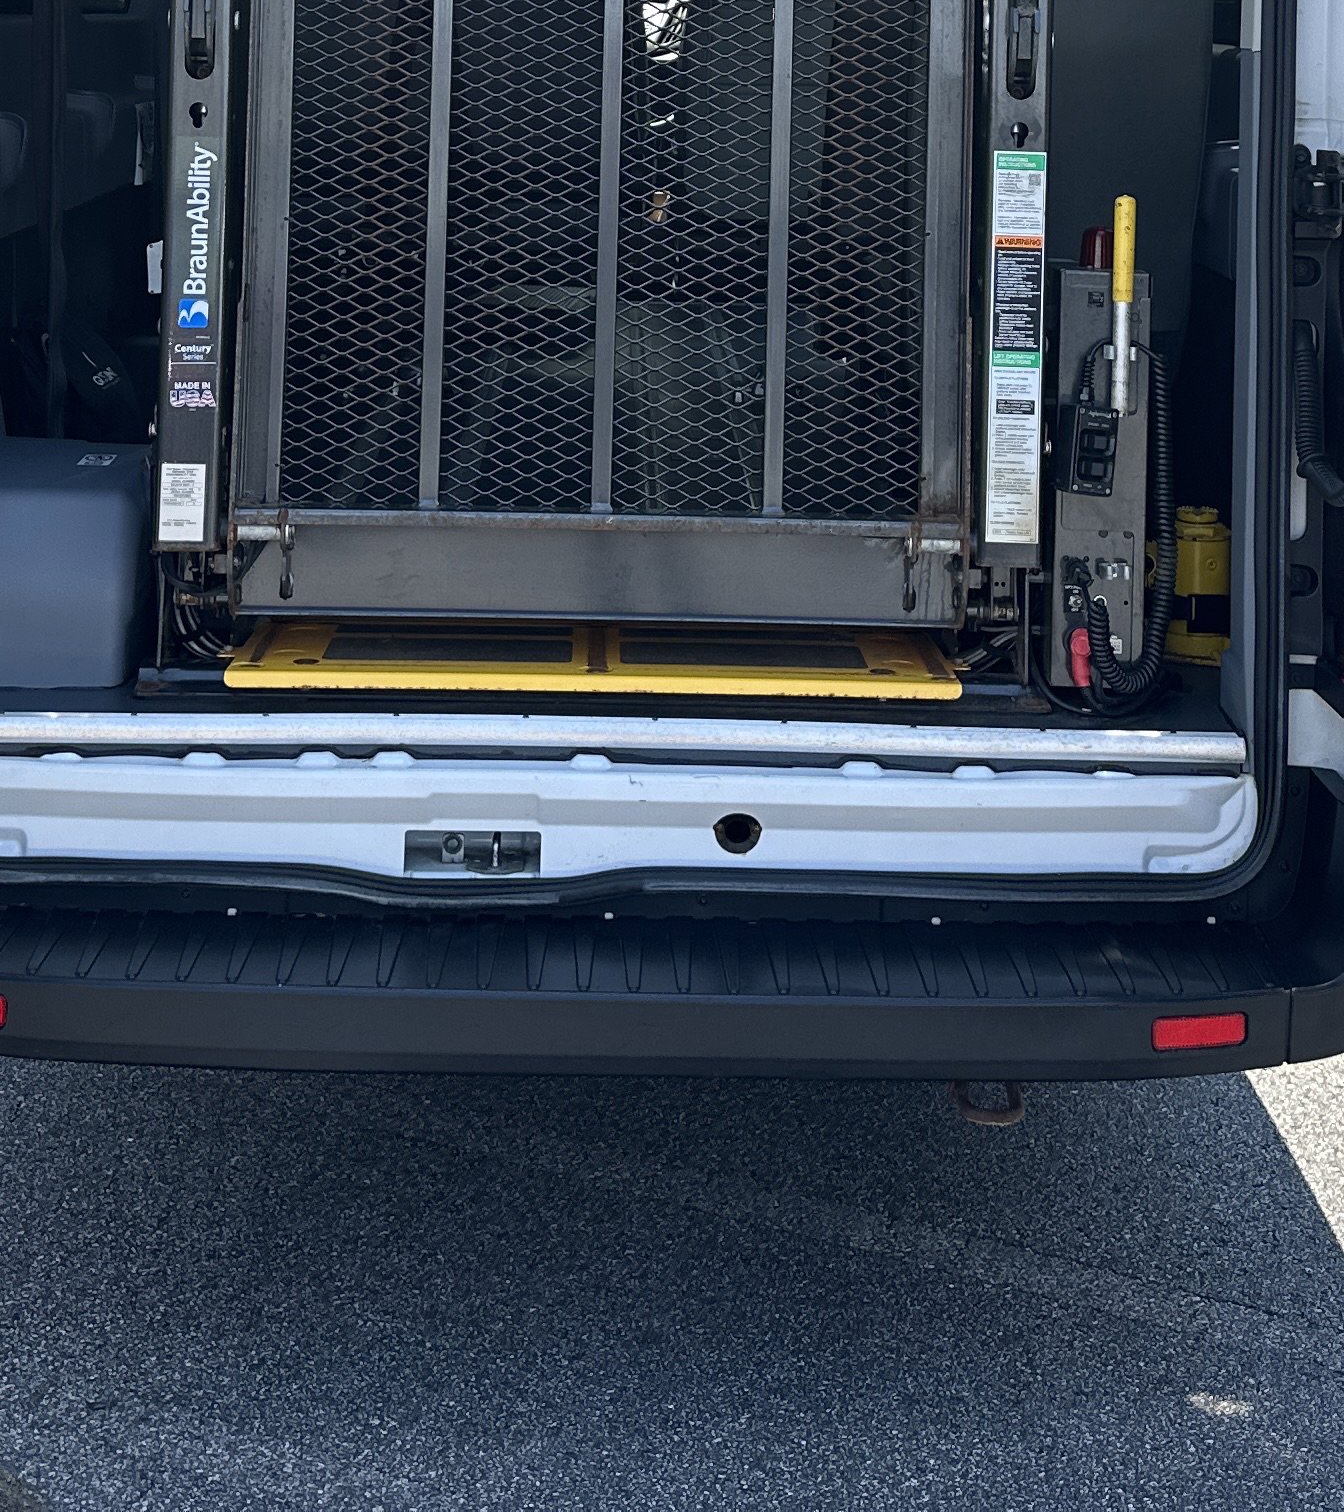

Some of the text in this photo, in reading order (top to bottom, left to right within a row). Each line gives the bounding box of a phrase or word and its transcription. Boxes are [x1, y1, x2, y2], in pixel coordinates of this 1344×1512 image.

[183, 144, 218, 295] BraunAbility
[174, 343, 212, 354] Century
[170, 390, 216, 407] USA
